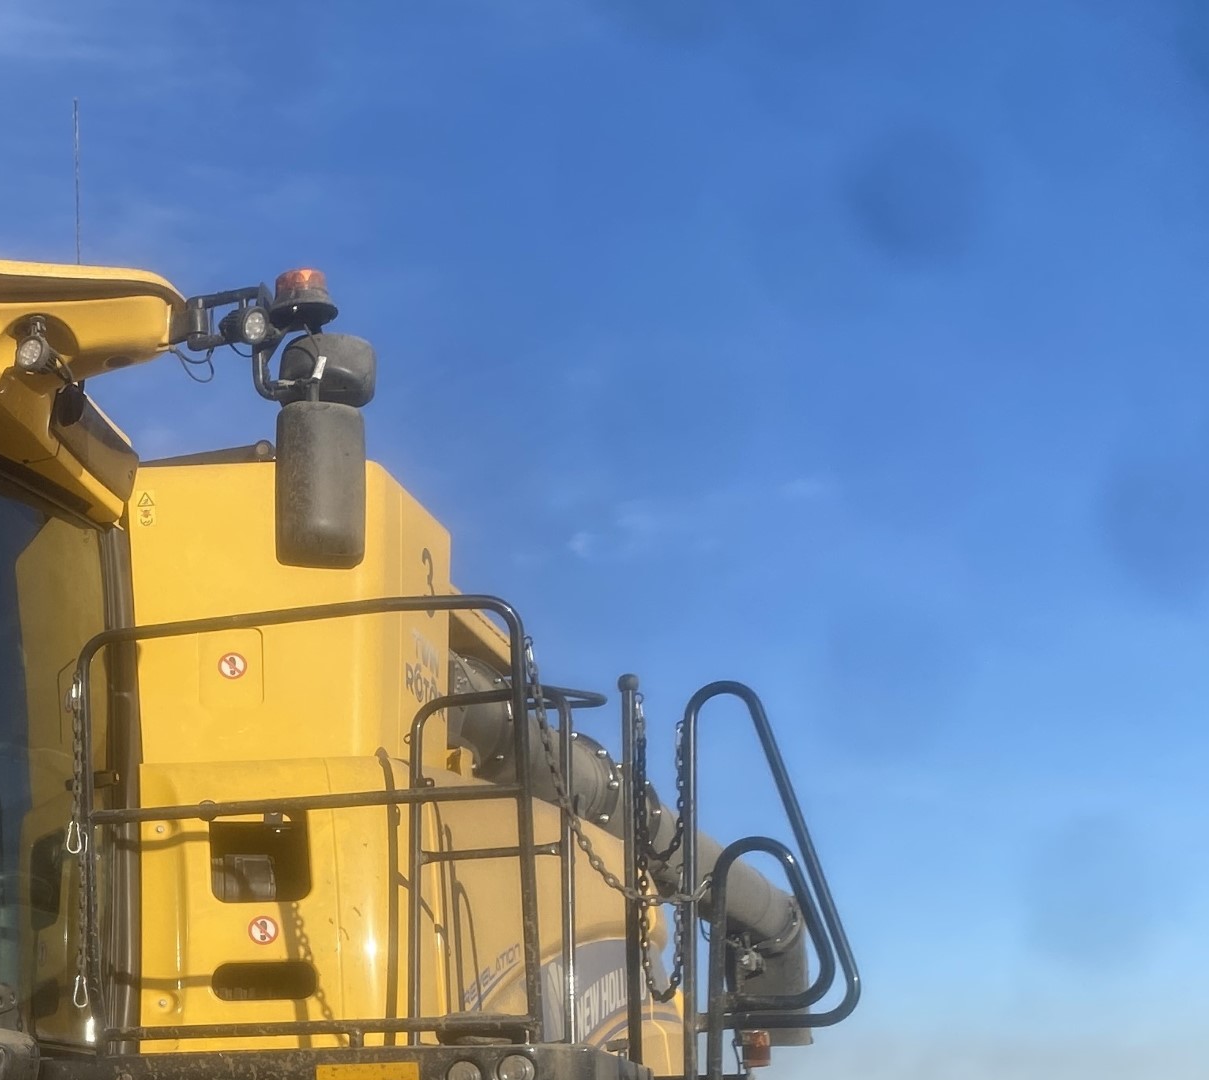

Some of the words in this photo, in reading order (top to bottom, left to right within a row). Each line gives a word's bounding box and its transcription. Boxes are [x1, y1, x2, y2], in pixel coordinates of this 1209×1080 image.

[464, 943, 520, 1005] REELATION
[576, 980, 600, 1044] NEW
[600, 966, 647, 1020] HOLLD
